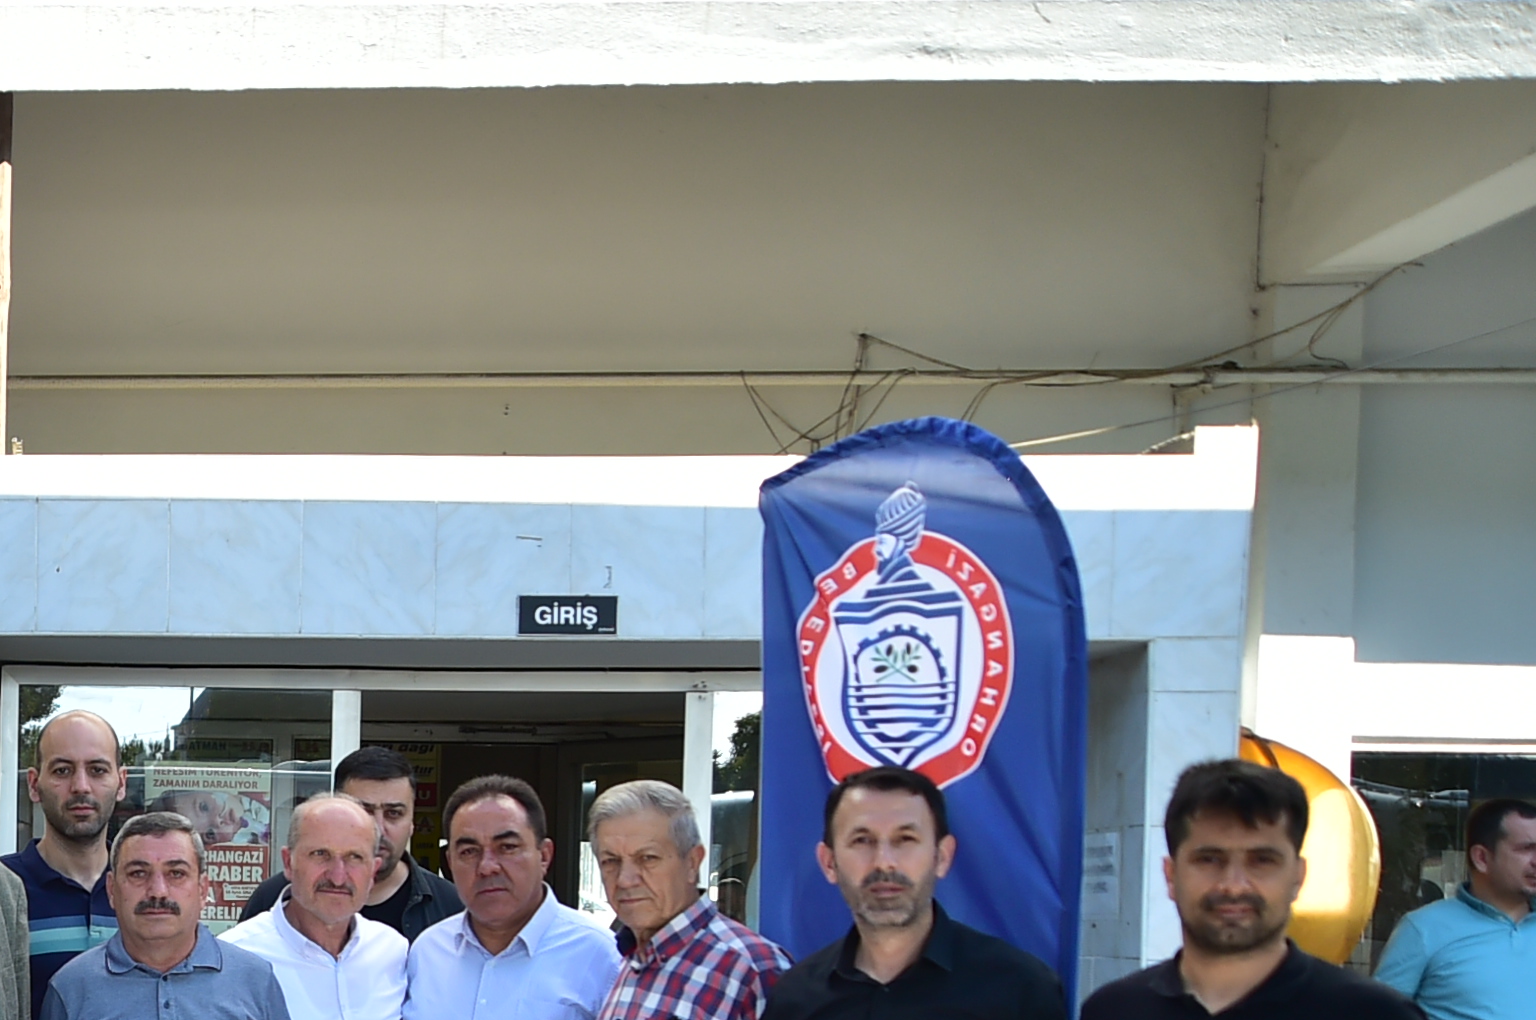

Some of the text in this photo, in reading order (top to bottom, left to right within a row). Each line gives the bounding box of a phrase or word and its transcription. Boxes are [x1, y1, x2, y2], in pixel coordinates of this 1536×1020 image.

[534, 601, 598, 630] GİRİŞ
[152, 778, 259, 789] ZAMANIM DARALIYOR
[204, 848, 264, 864] RHANGAZİ
[207, 865, 263, 882] RABER
